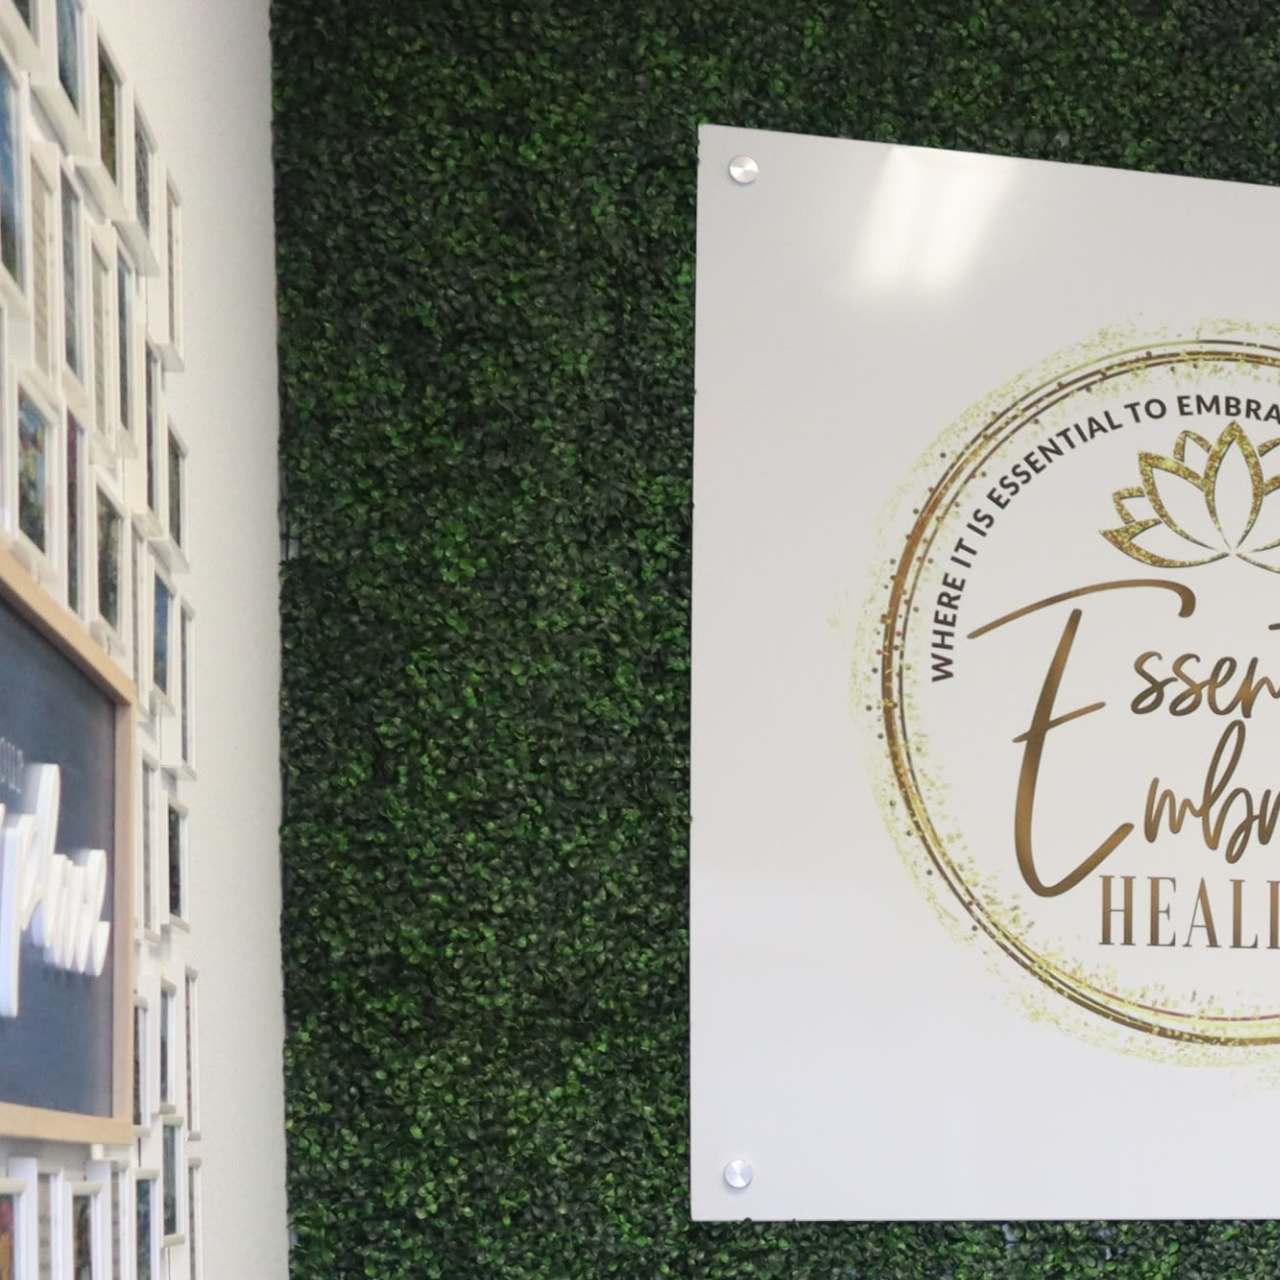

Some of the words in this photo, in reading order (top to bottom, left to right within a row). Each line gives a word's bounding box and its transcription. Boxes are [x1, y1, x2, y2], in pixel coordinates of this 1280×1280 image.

[930, 572, 966, 683] WHERE
[950, 536, 979, 570] IT
[966, 508, 995, 539] IS
[986, 410, 1124, 511] ESSENTIAL
[1123, 397, 1168, 424] TO
